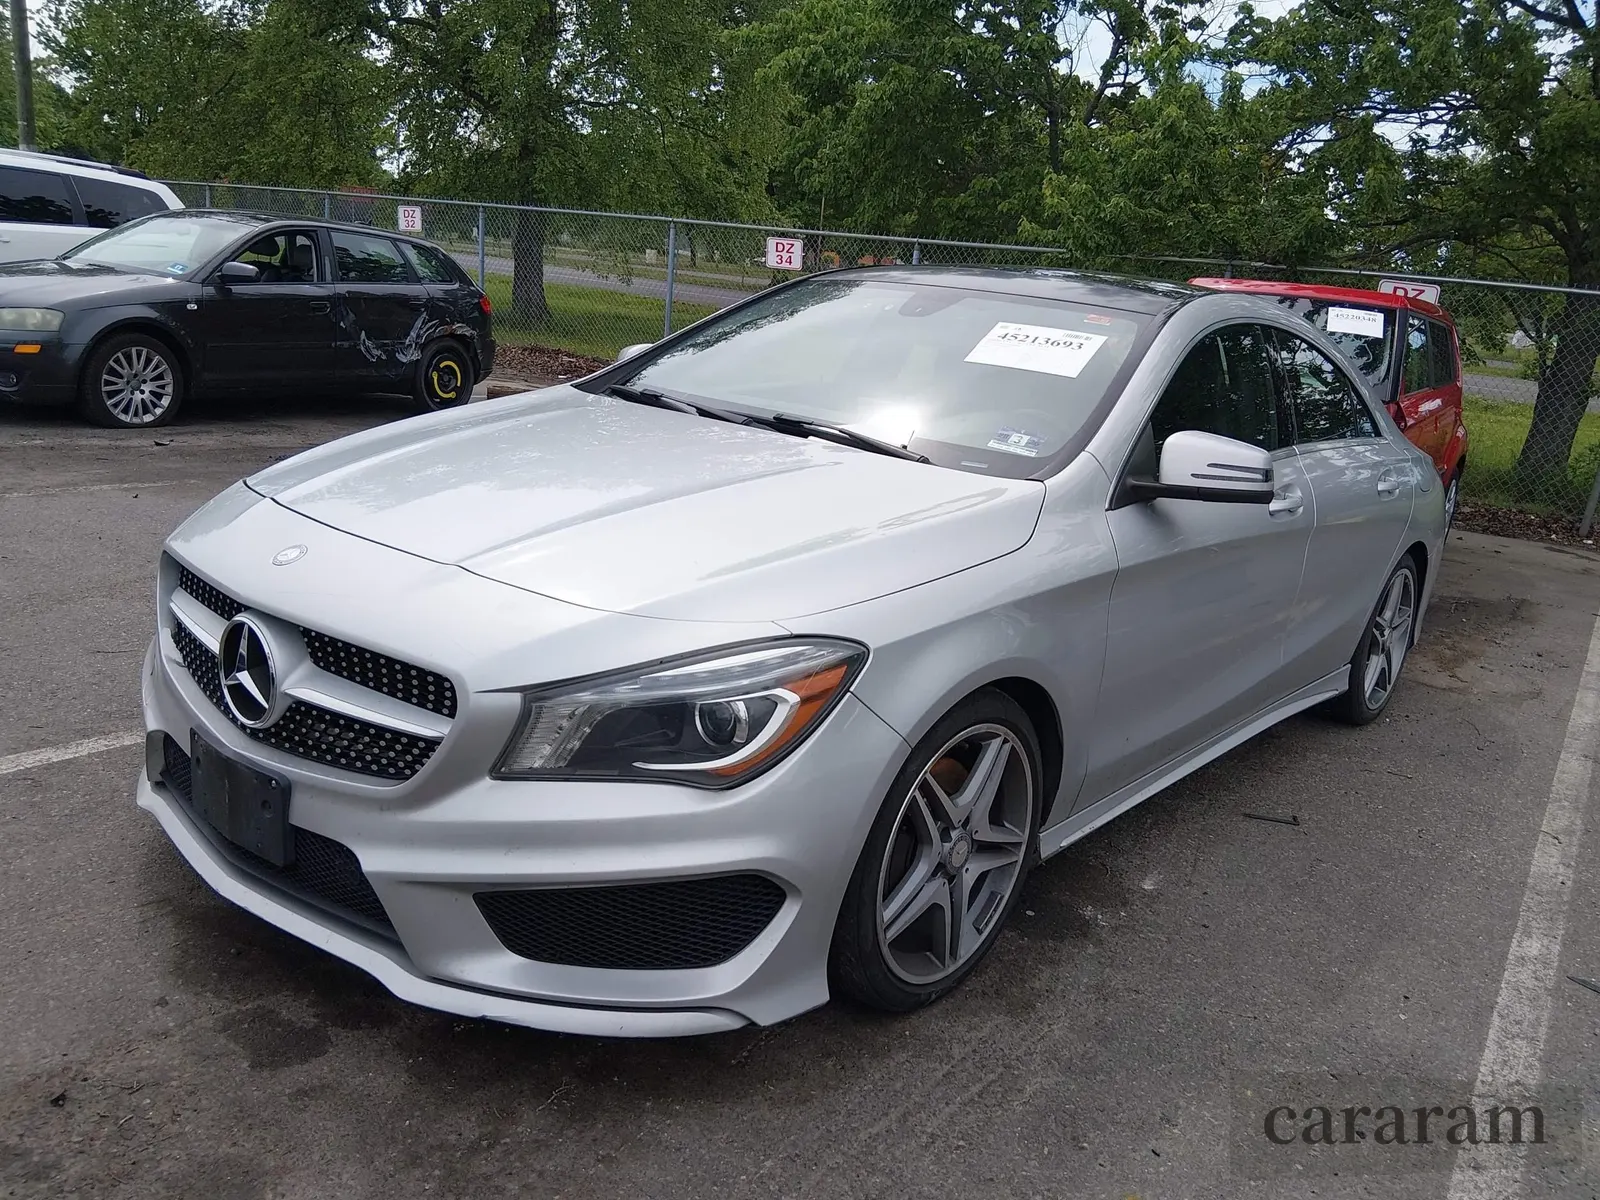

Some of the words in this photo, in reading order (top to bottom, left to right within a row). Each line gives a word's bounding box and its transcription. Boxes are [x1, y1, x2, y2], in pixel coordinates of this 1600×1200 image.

[403, 209, 417, 219] DZ
[404, 219, 416, 229] 32
[775, 241, 795, 254] DZ
[775, 254, 793, 266] 34
[997, 331, 1084, 351] 45213693
